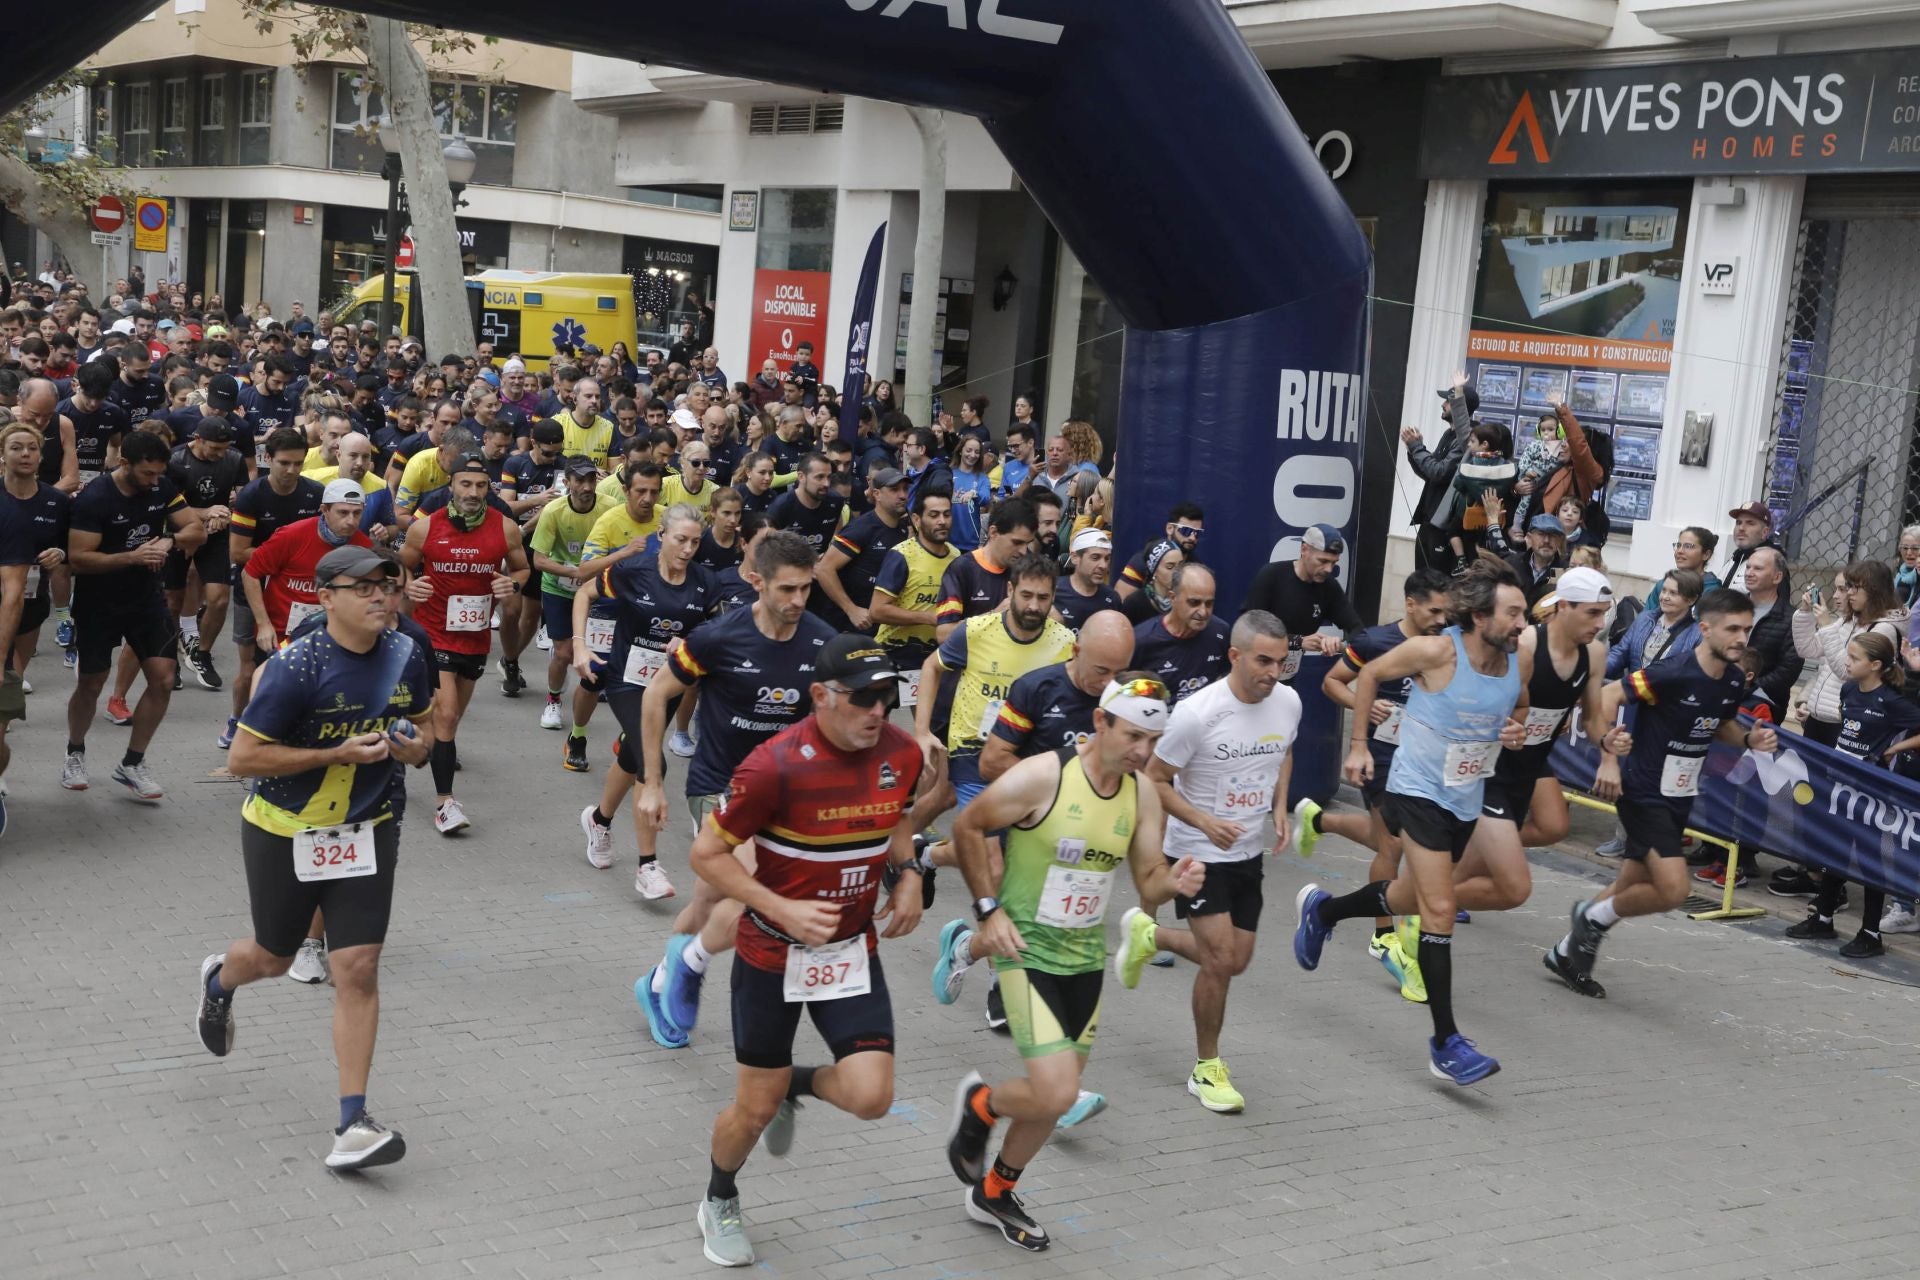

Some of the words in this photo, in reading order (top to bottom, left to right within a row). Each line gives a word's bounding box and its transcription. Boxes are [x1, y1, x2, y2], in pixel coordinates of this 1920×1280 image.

[1549, 82, 1682, 136] VIVES
[1697, 72, 1846, 129] PONS
[1691, 133, 1838, 160] HOMES
[656, 250, 694, 264] MACSON
[1704, 263, 1733, 281] VP
[775, 285, 804, 300] LOCAL
[764, 300, 817, 317] DISPONIBLE
[1471, 337, 1507, 353] ESTUDIO
[1509, 340, 1521, 354] DE
[1522, 342, 1590, 358] ARQUITECTURA
[1592, 346, 1600, 358] Y
[1276, 368, 1361, 444] RUTA
[432, 561, 468, 573] NUCLEO
[458, 609, 485, 623] 334
[650, 616, 684, 631] 200
[589, 632, 614, 646] 175
[757, 686, 800, 704] 200
[1225, 790, 1265, 808] 3401
[312, 843, 358, 867] 324
[1061, 895, 1100, 916] 150
[804, 962, 851, 987] 387
